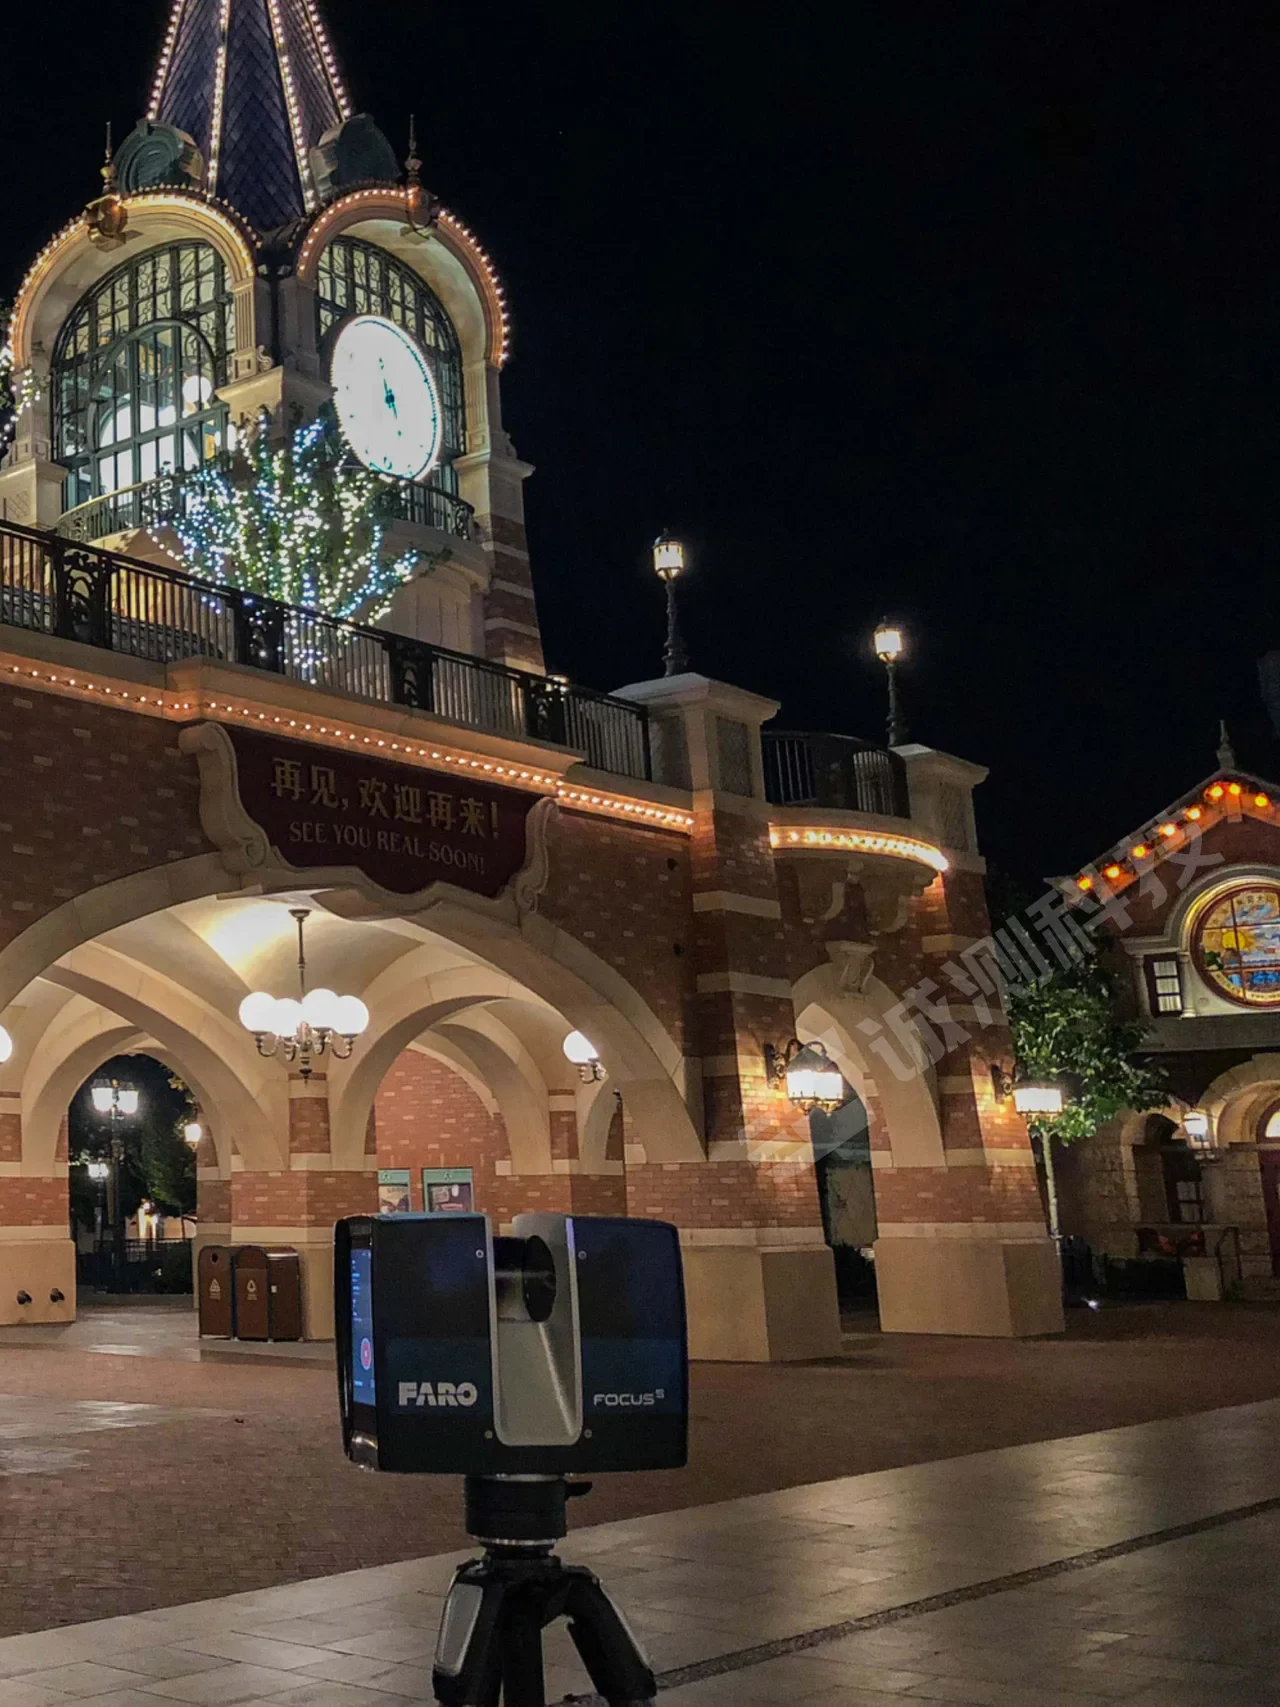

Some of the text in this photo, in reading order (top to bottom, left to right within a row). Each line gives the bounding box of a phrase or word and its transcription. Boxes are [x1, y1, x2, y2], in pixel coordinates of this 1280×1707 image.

[289, 821, 486, 875] SEE YOU REAL SOON!
[398, 1382, 478, 1406] FARO
